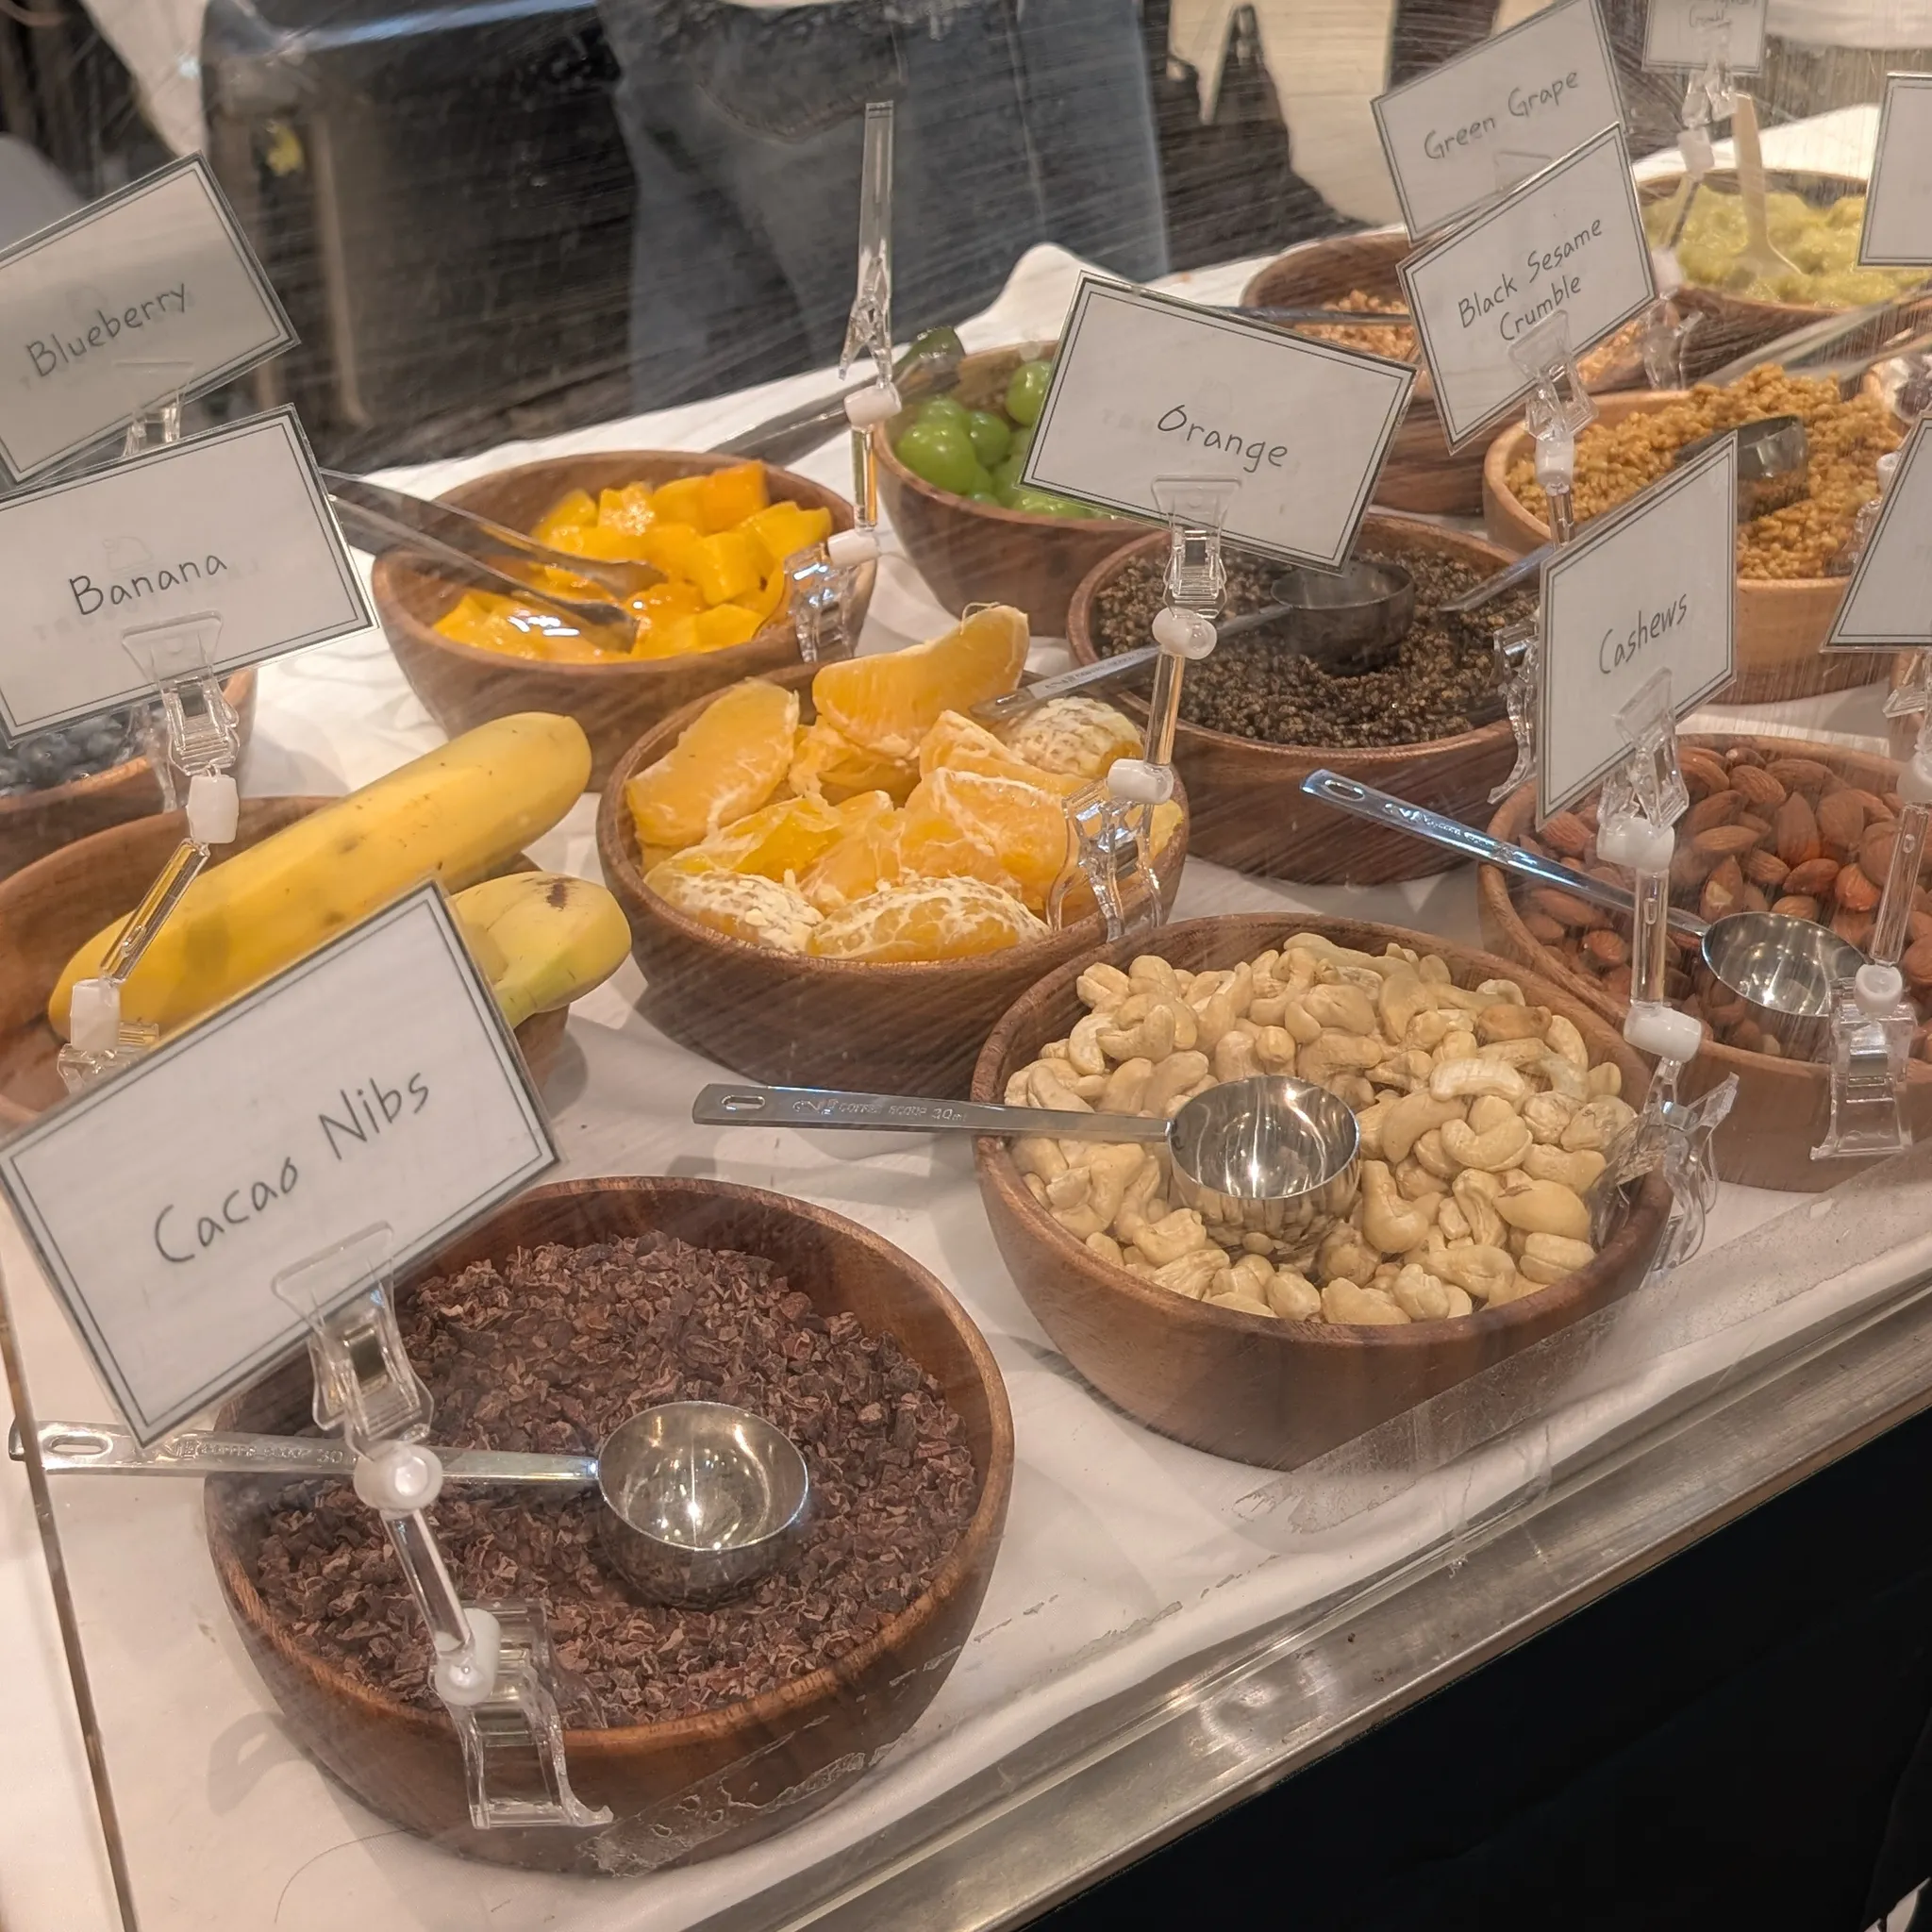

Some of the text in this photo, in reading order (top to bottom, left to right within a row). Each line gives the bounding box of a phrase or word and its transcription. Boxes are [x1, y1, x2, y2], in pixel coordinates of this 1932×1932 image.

[1424, 71, 1578, 159] Green Grape
[1457, 219, 1603, 328] Black Sesame
[1499, 275, 1582, 341] Crumble
[25, 282, 188, 379] Blueberry
[1157, 404, 1289, 474] Orange
[69, 554, 227, 616] Banana
[1598, 592, 1688, 675] Cashews
[154, 1072, 430, 1264] Cacao Nibs
